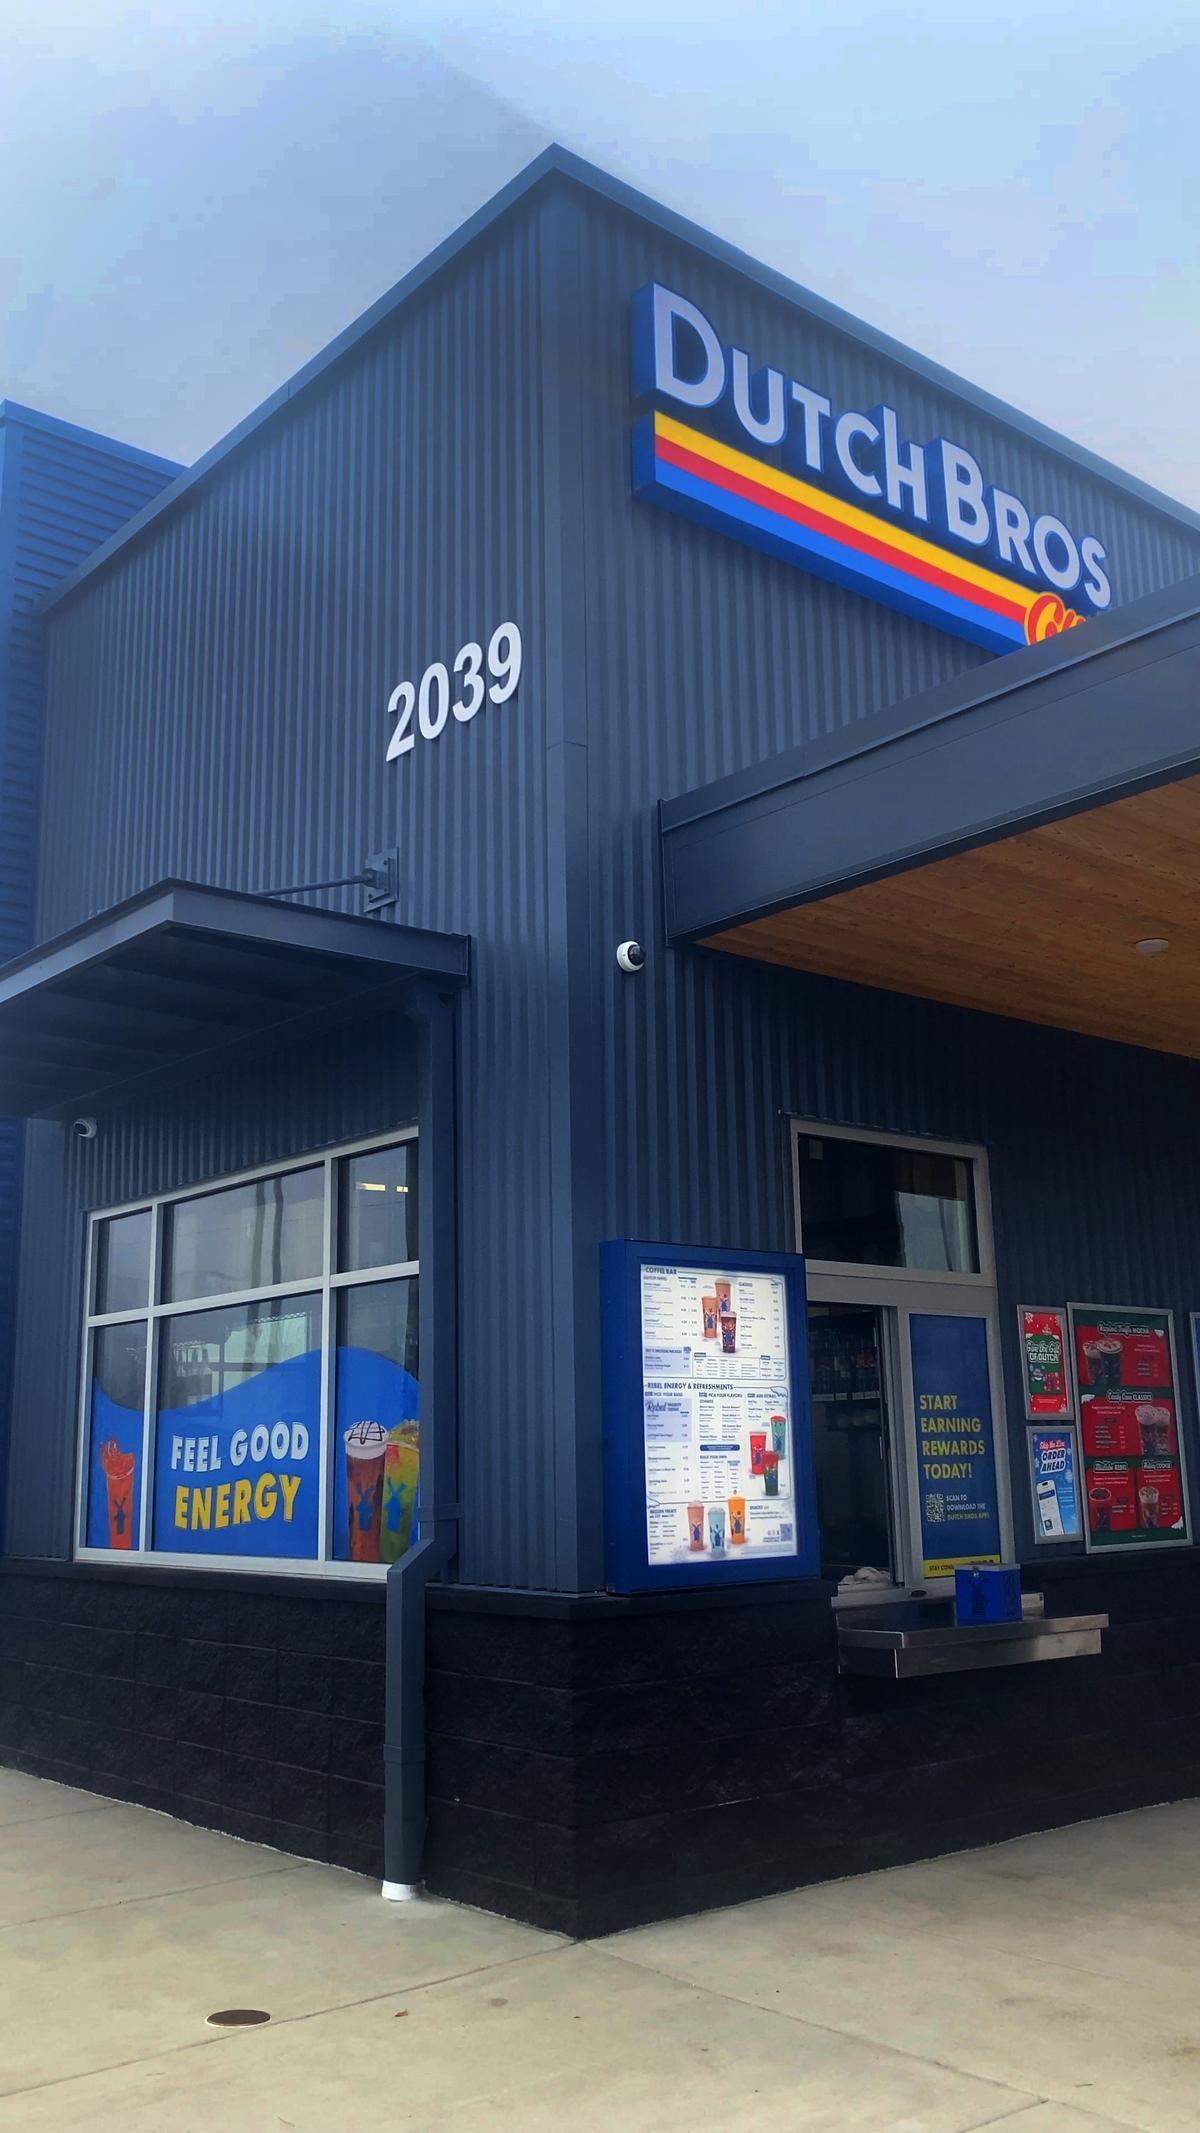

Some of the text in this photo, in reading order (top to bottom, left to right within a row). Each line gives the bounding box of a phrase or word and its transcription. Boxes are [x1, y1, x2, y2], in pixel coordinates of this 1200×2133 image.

[653, 282, 1113, 609] DUTCH BROS
[385, 621, 523, 763] 2039
[664, 1382, 687, 1390] ENERGY
[687, 1382, 692, 1390] &
[692, 1383, 734, 1391] REFRESHMENTS
[919, 1394, 958, 1411] START
[920, 1417, 982, 1433] EARNING
[170, 1421, 310, 1473] FEEL GOOD
[921, 1439, 986, 1456] REWARDS
[1042, 1449, 1066, 1461] ORDER
[922, 1462, 973, 1480] TODAY!
[1041, 1460, 1066, 1472] AHEAD
[173, 1471, 302, 1531] ENERGY
[946, 1503, 977, 1511] DOWNLOAD
